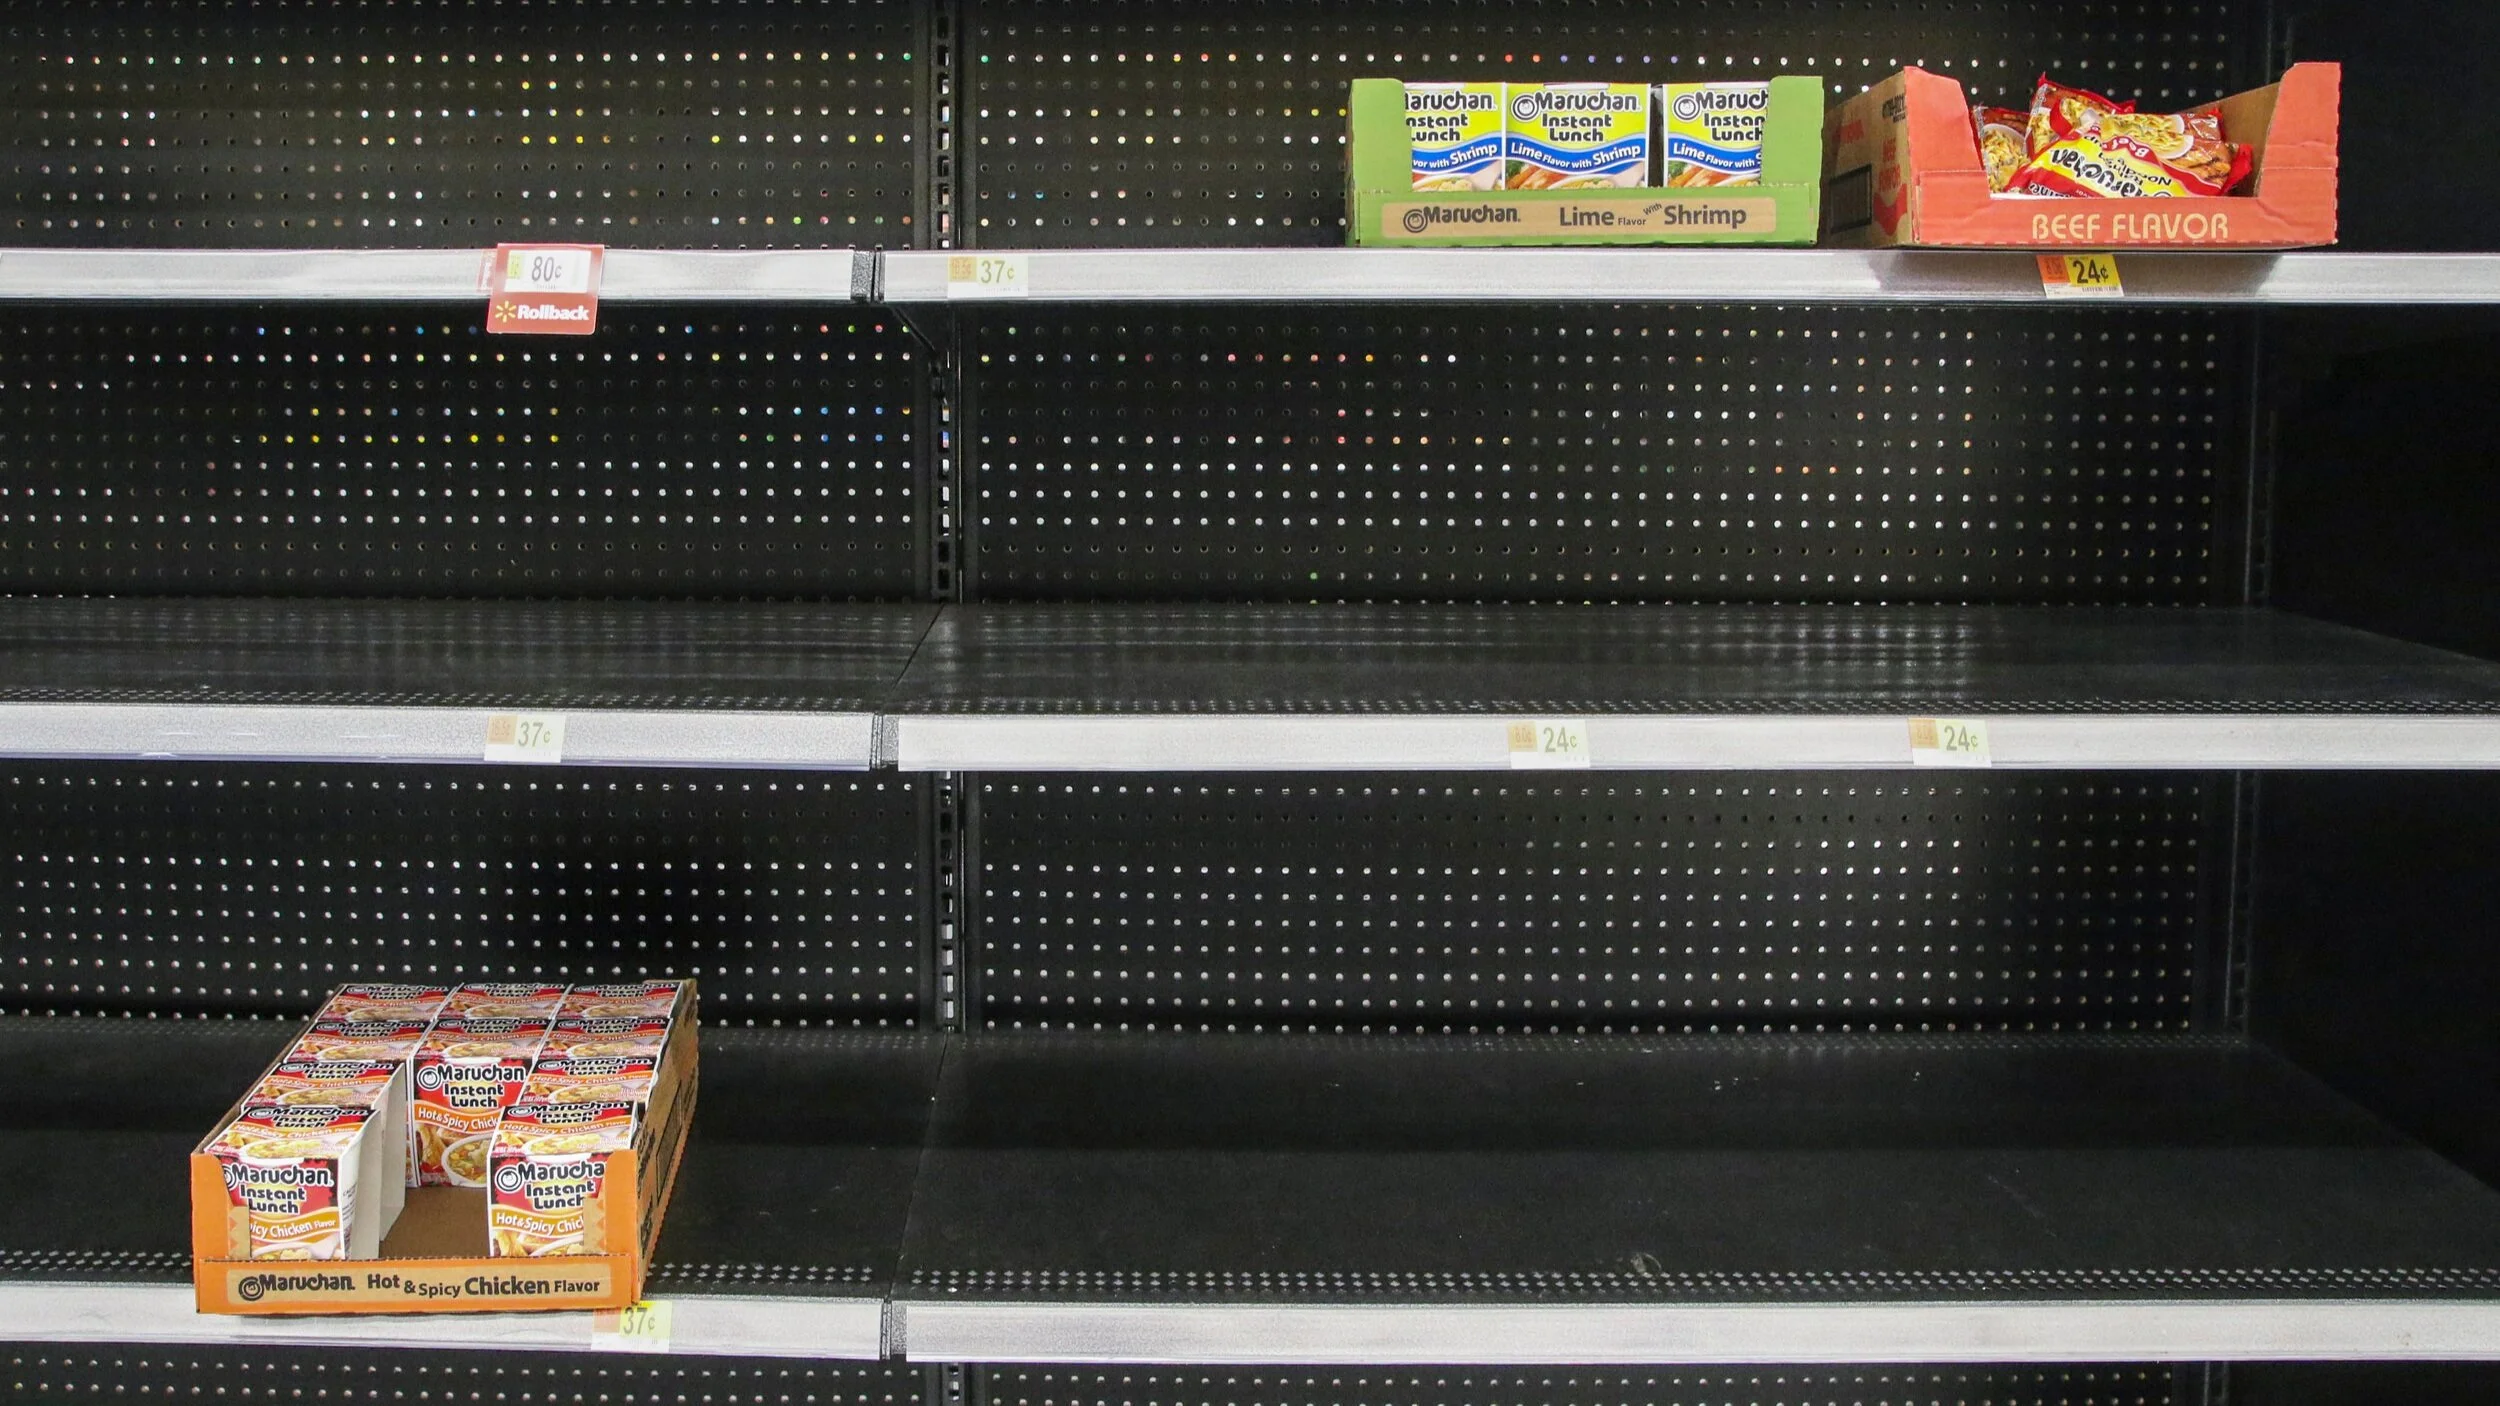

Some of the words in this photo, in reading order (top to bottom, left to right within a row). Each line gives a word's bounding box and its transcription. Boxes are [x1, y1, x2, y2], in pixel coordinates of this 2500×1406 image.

[1405, 91, 1493, 110] aruchan
[1535, 92, 1638, 111] Maruchan
[1405, 113, 1468, 128] nstant
[1542, 114, 1612, 128] Instant
[1704, 113, 1766, 128] Instan
[1411, 128, 1461, 141] unch
[1550, 128, 1604, 142] Lunch
[1413, 159, 1428, 168] vor
[1429, 159, 1450, 169] with
[1449, 143, 1498, 166] Shrimp
[1511, 142, 1542, 160] Lime
[1542, 154, 1571, 169] Flavor
[1571, 159, 1592, 169] with
[1593, 145, 1641, 166] Shrimp
[1673, 142, 1705, 161] Lime
[1705, 154, 1733, 168] Flavor
[1734, 158, 1755, 169] with
[1424, 204, 1519, 224] Maruchan
[1559, 206, 1615, 228] Lime
[1617, 216, 1648, 227] Flavor
[1643, 202, 1663, 216] With
[1663, 204, 1747, 229] Shrimp
[2032, 213, 2101, 240] BEEF
[2112, 213, 2229, 240] FLAVOR
[2072, 259, 2109, 284] 24¢
[518, 304, 590, 321] Rollback
[302, 1062, 394, 1070] Maruchan
[560, 1058, 652, 1066] Maruchan
[437, 1065, 525, 1081] Maruchan
[444, 1083, 504, 1096] Instant
[451, 1096, 498, 1107] Lunch
[531, 1102, 629, 1112] Maruchan
[272, 1107, 368, 1116] Maruchan
[471, 1116, 500, 1131] Chick
[560, 1123, 604, 1134] Chicken
[287, 1128, 334, 1138] Chicken
[232, 1163, 329, 1186] Maruchan
[518, 1160, 605, 1181] Marucha
[240, 1184, 306, 1201] Instant
[526, 1180, 595, 1197] Instant
[248, 1198, 299, 1214] Lunch
[270, 1221, 313, 1238] Chicken
[314, 1219, 336, 1229] Flavor
[259, 1273, 354, 1291] Maruchan
[367, 1273, 400, 1289] Hot
[404, 1280, 416, 1294] &
[418, 1282, 461, 1298] Spicy
[464, 1275, 550, 1295] Chicken
[554, 1279, 600, 1293] Flavor
